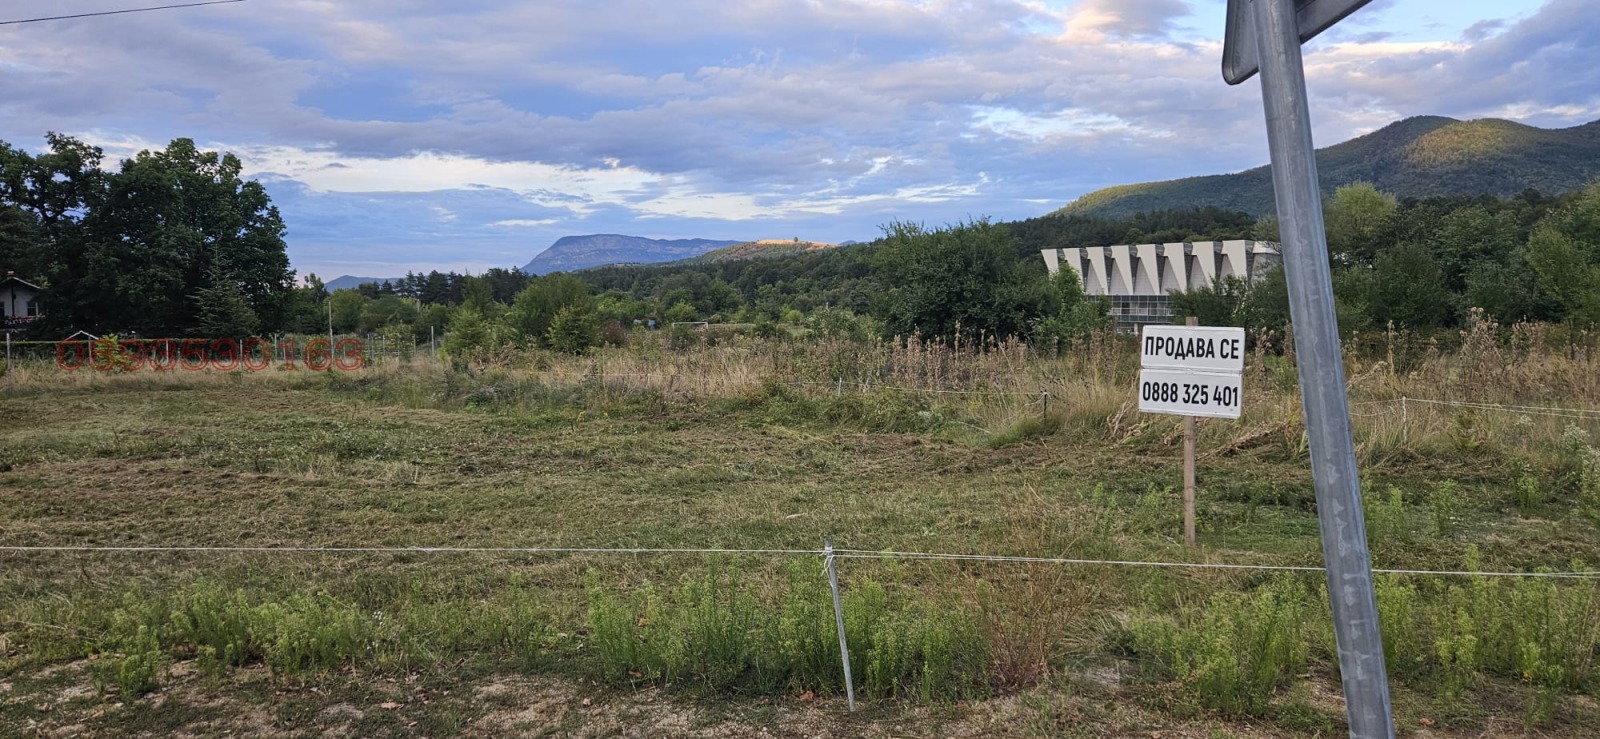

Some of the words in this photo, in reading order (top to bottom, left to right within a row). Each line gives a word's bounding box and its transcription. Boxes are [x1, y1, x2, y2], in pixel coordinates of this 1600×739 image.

[1144, 336, 1215, 360] ПРОДАВА
[1219, 338, 1239, 359] СЕ
[1142, 381, 1178, 403] 0888
[1182, 383, 1209, 405] 325
[1212, 385, 1238, 407] 401
